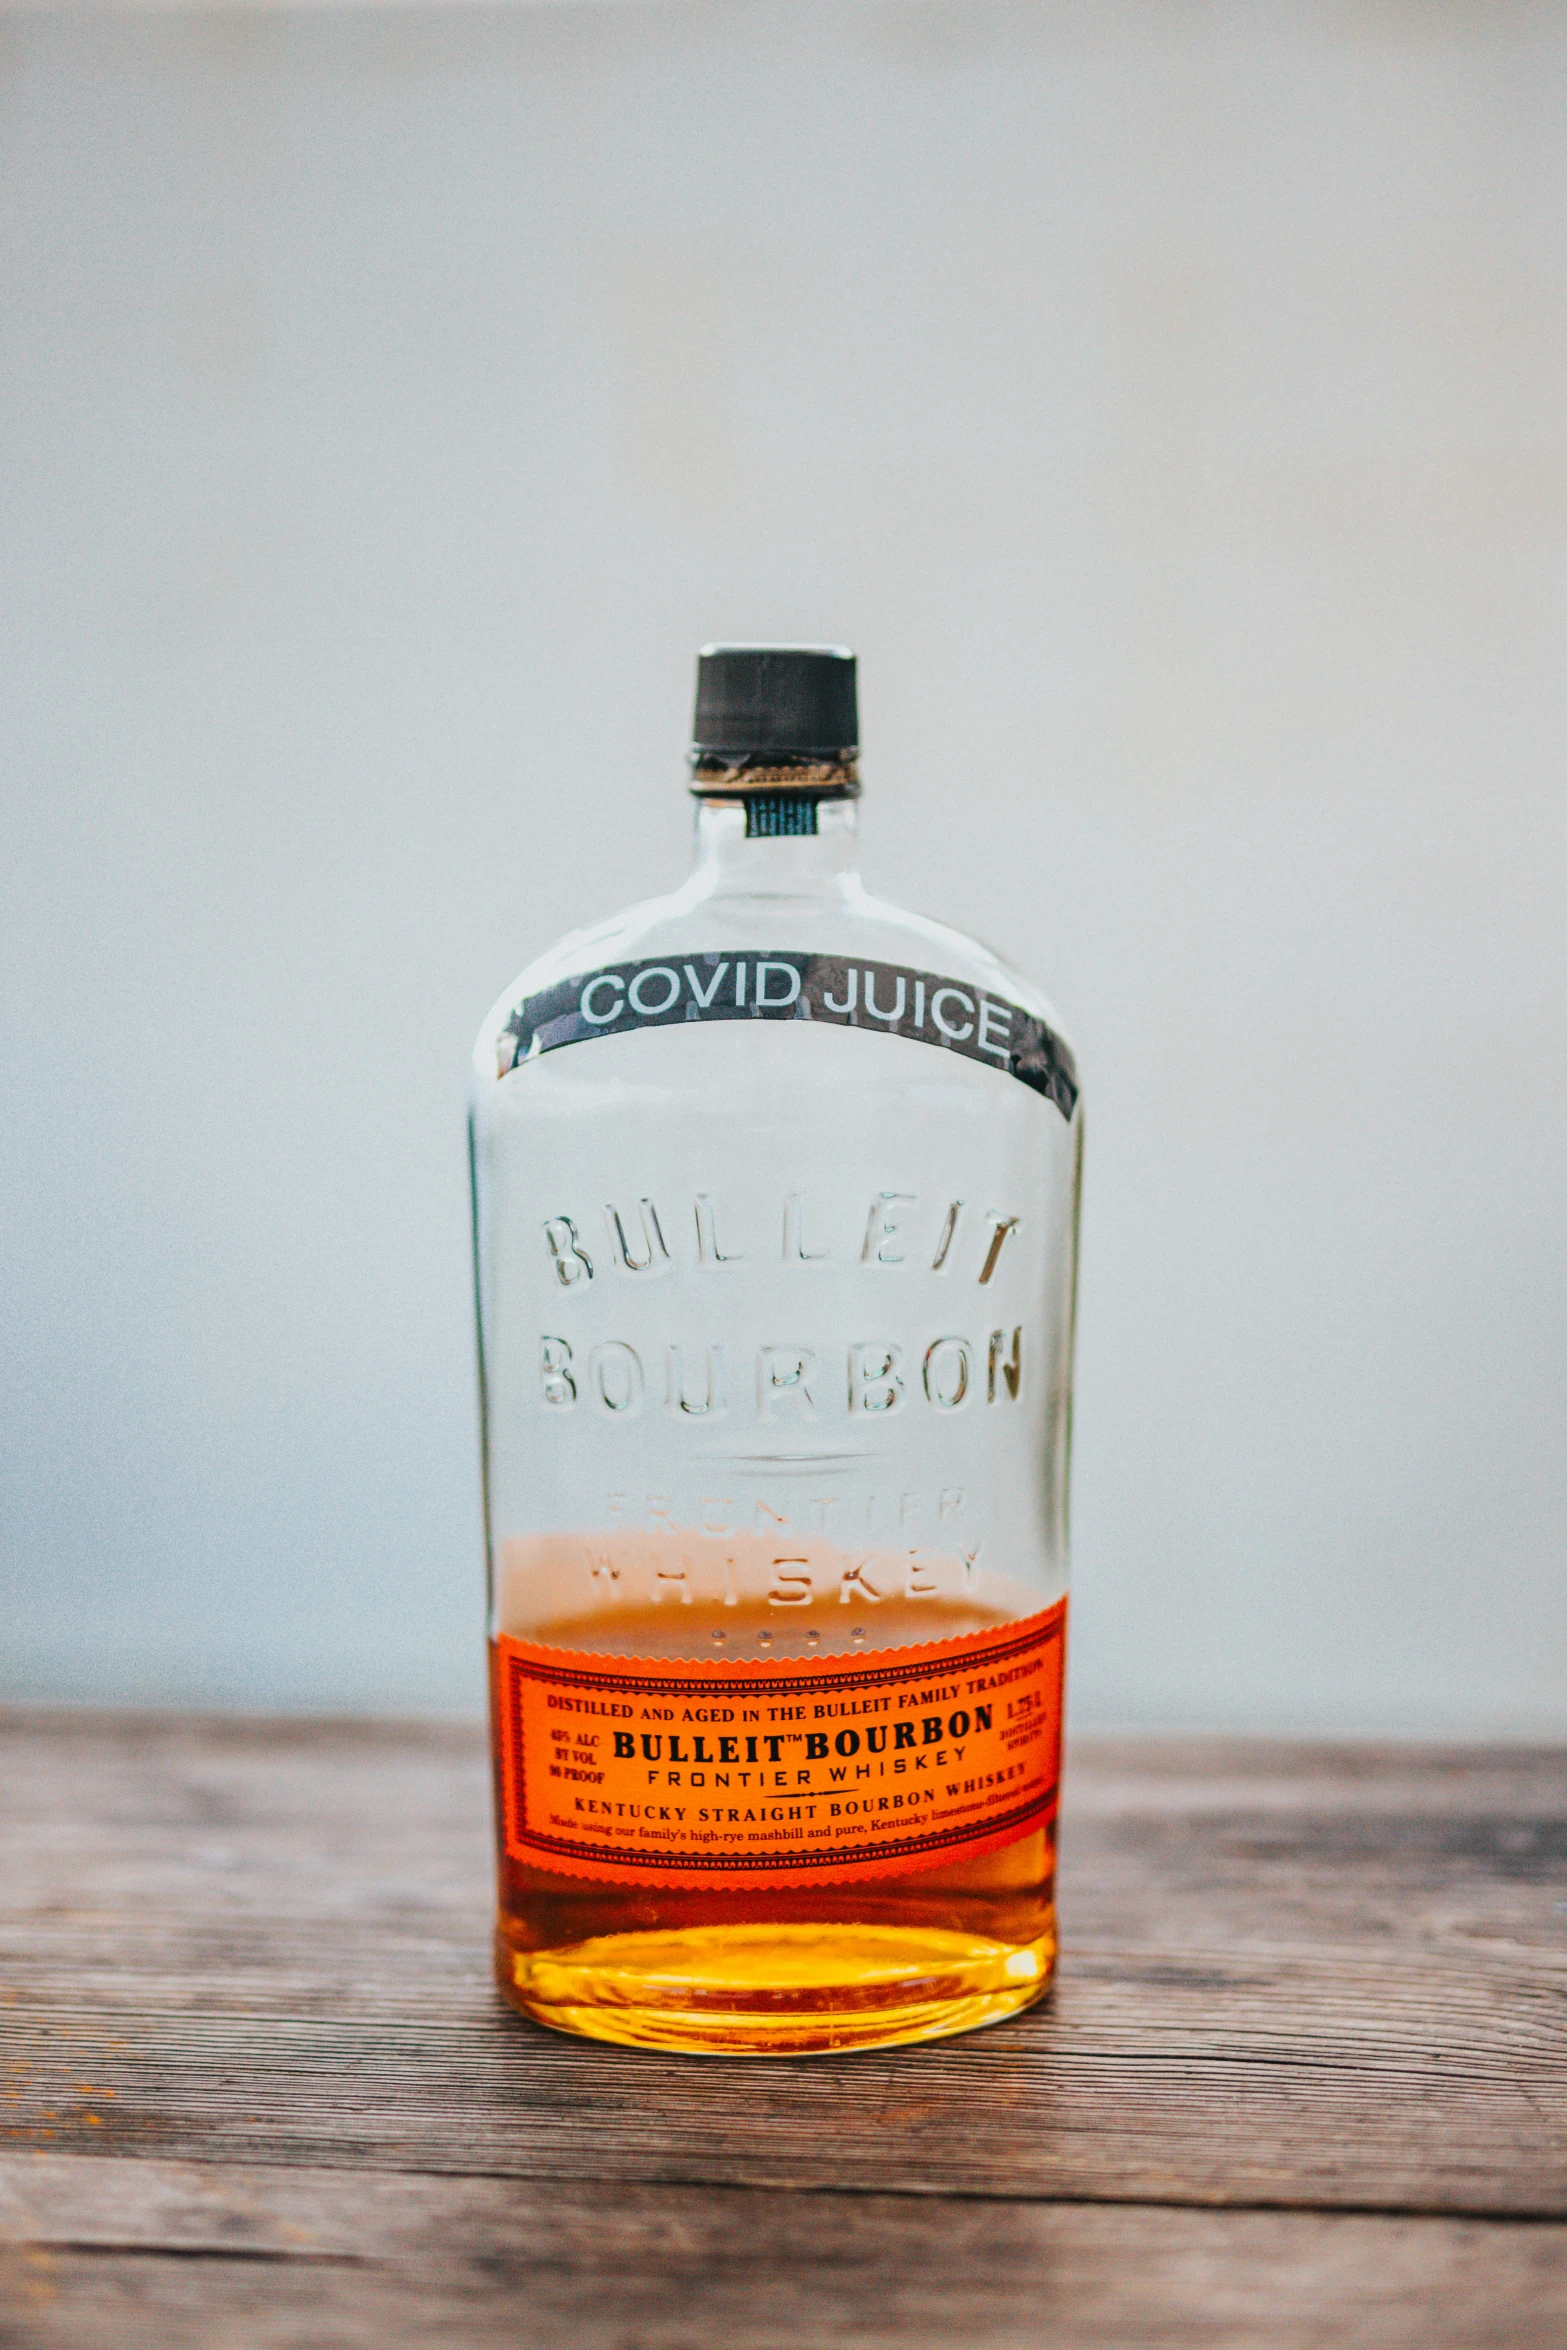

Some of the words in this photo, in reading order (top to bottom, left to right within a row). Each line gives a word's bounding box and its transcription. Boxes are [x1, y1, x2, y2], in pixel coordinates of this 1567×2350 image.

[581, 962, 802, 1026] COVID
[823, 969, 1013, 1057] JUICE
[542, 1191, 1021, 1286] BULLEIT
[539, 1326, 1023, 1420] BOURBON
[605, 1488, 966, 1537] FRONTIER
[585, 1542, 983, 1605] WHISKEY
[547, 1695, 633, 1718] DISTILLED
[641, 1709, 674, 1721] AND
[682, 1709, 734, 1722] AGED
[743, 1711, 759, 1721] IN
[768, 1707, 807, 1721] THE
[814, 1698, 891, 1719] BULLEIT
[898, 1685, 959, 1708] FAMILY
[968, 1658, 1043, 1694] TRADITION
[573, 1750, 596, 1765] VOL
[576, 1733, 600, 1747] ALC
[806, 1704, 992, 1760] BOURBON
[564, 1767, 605, 1784] PROOF
[574, 1798, 687, 1821] KENTUCKY
[699, 1807, 818, 1821] STRAIGHT
[830, 1789, 936, 1817] BOURBON
[946, 1762, 1026, 1797] WHISKEY
[648, 1770, 811, 1787] FRONTIER
[830, 1745, 967, 1780] WHISKEY
[616, 1828, 636, 1836] our
[690, 1830, 744, 1843] high-rye
[748, 1828, 803, 1841] mashbill
[807, 1826, 831, 1838] and
[835, 1825, 868, 1838] pure,
[870, 1812, 928, 1831] Kentucky
